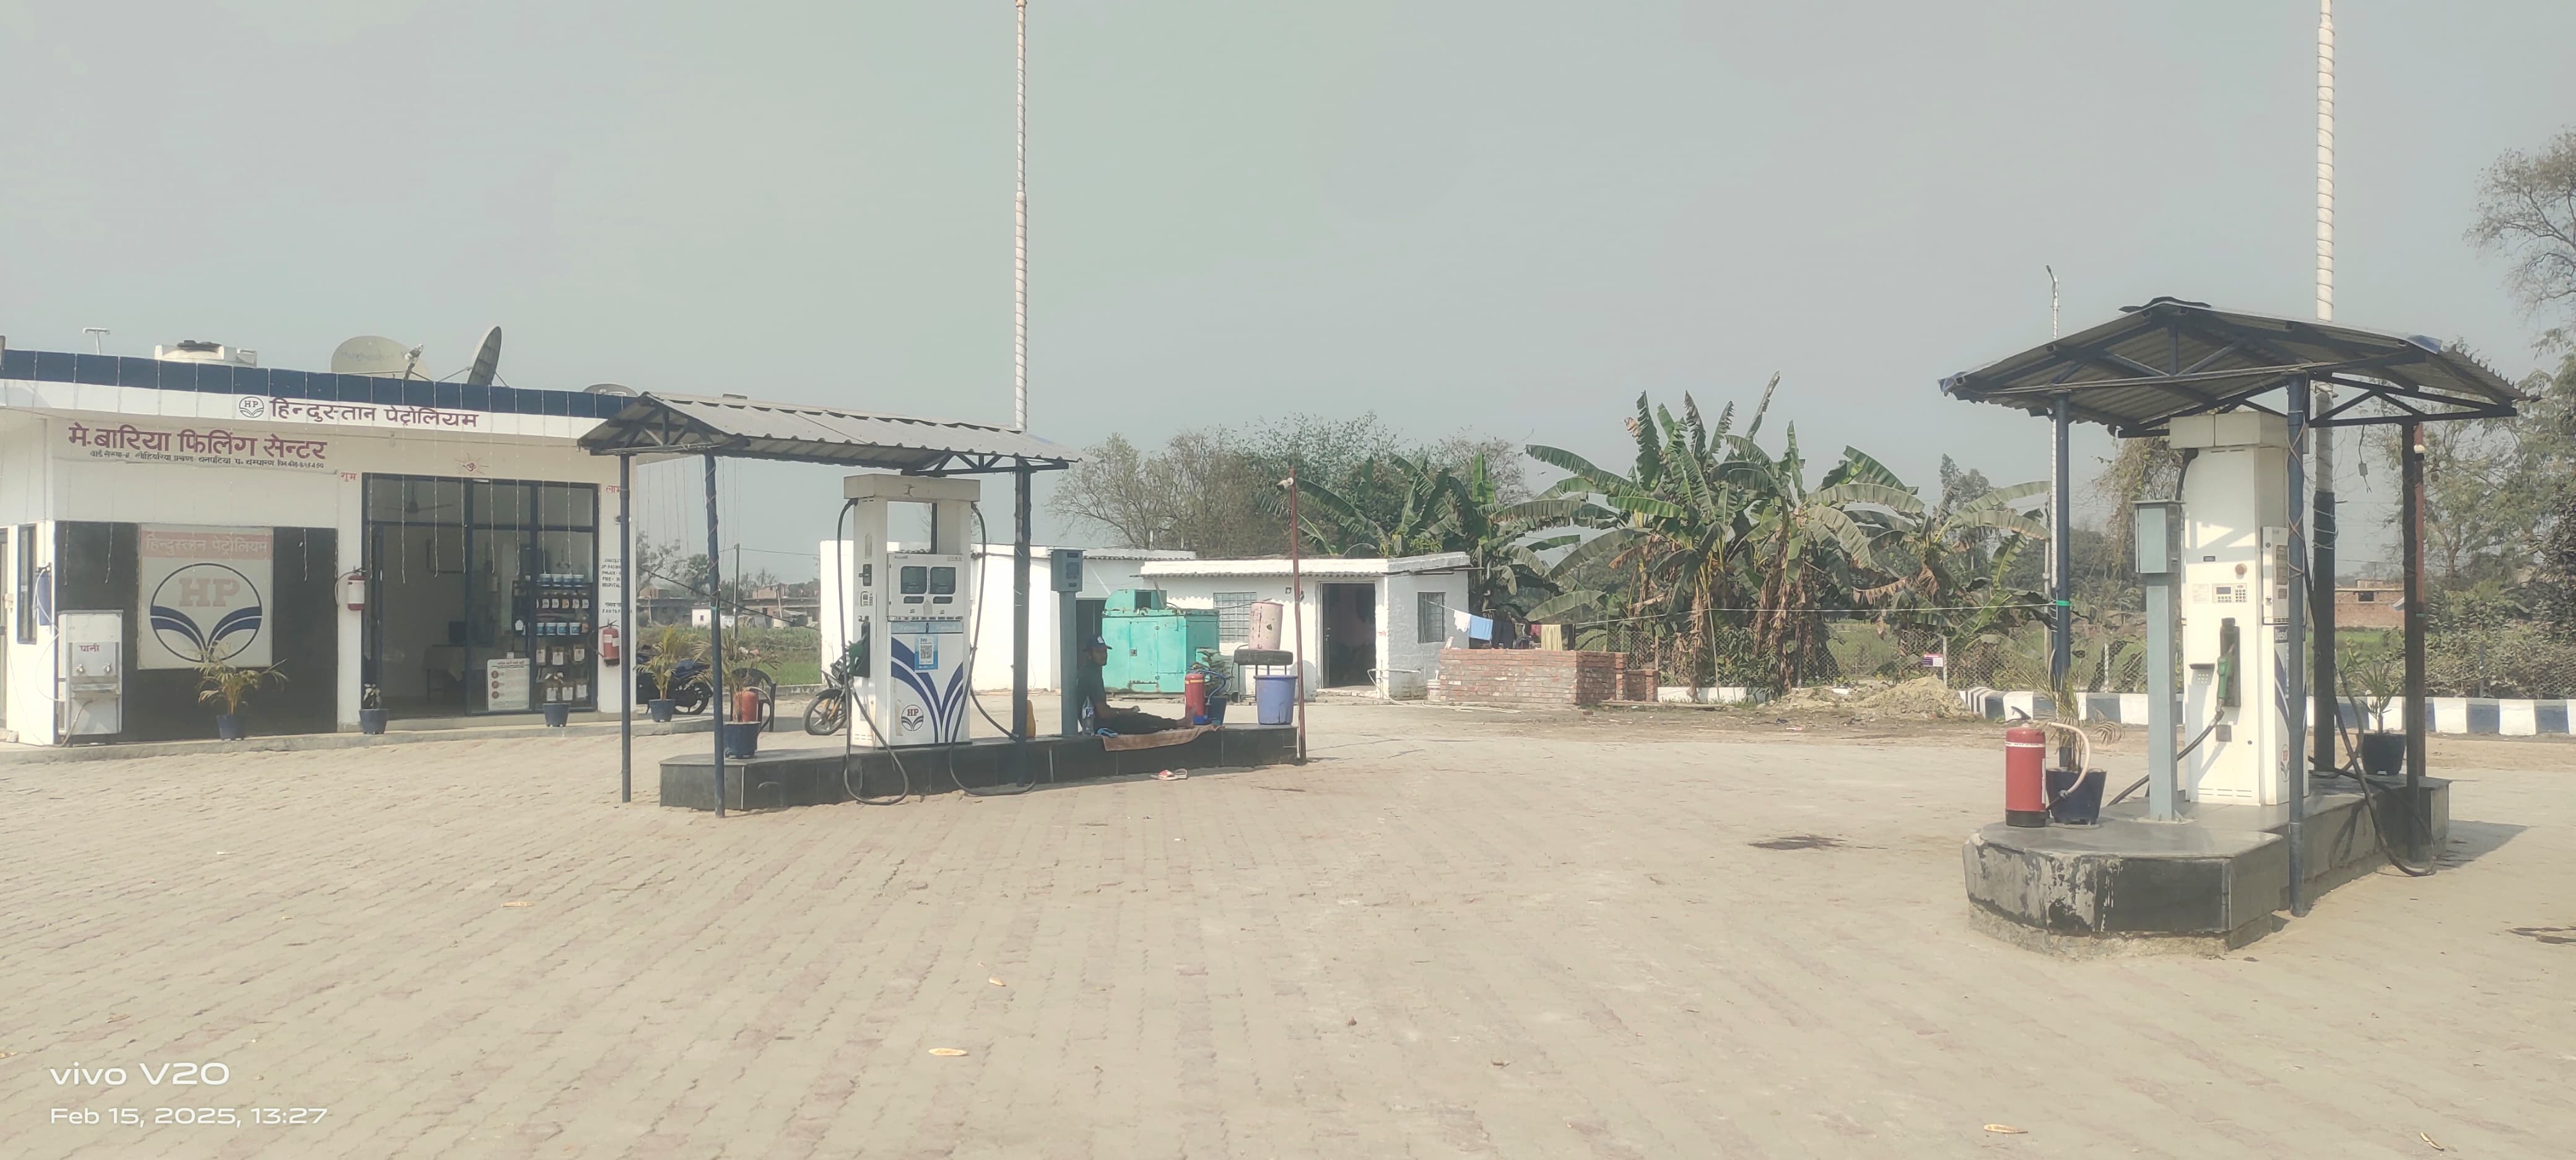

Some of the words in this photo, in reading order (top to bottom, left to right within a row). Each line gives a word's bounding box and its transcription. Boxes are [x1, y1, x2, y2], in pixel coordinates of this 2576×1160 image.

[269, 397, 376, 422] हिन्दुस्तान
[384, 405, 479, 427] पेट्रोलियम
[177, 428, 258, 456] फिलिंग
[263, 433, 328, 459] सेन्टर
[146, 534, 206, 555] हिन्दुस्तान
[212, 535, 269, 555] पेट्रोलियम
[178, 578, 240, 607] HP
[79, 643, 100, 652] पानी
[907, 708, 919, 716] HP
